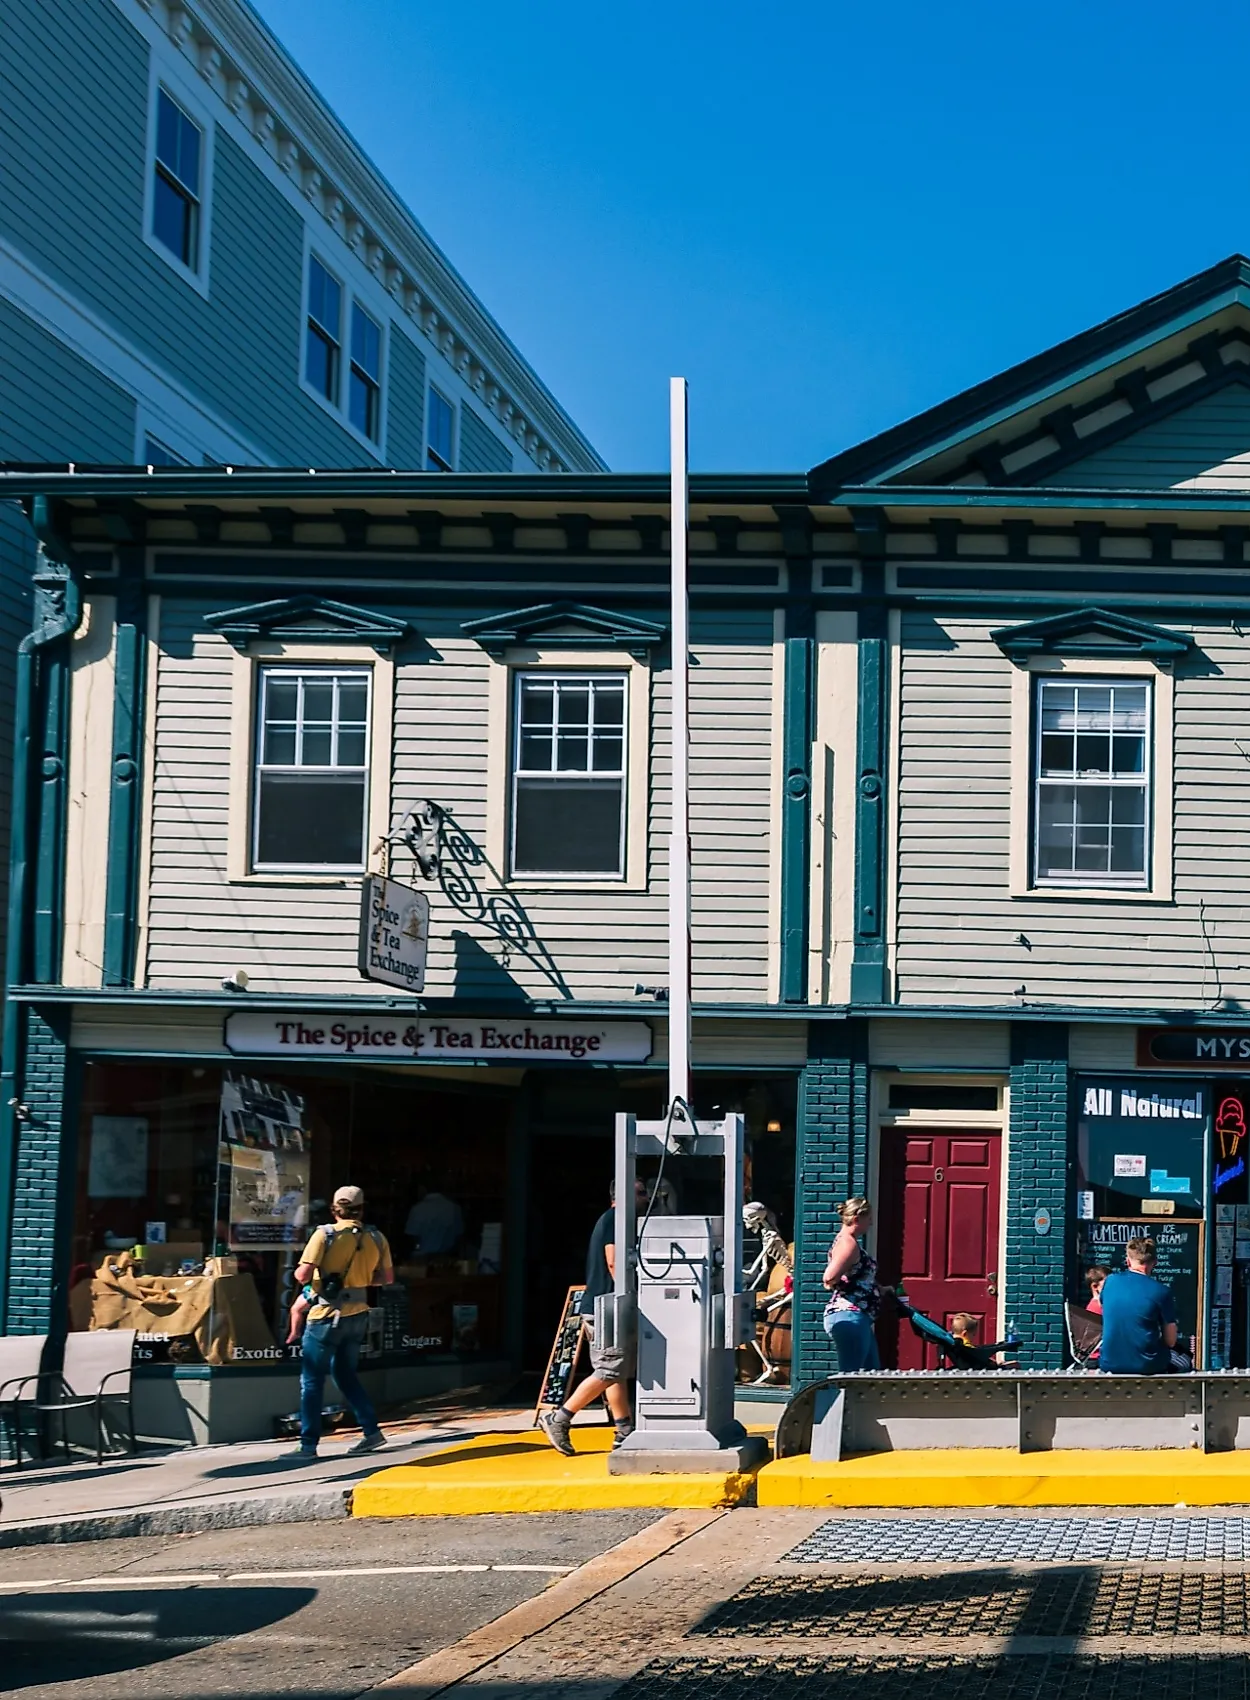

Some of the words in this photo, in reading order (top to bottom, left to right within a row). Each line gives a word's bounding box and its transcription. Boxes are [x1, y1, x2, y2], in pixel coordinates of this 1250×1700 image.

[372, 899, 400, 926] Spice
[383, 927, 401, 950] Tea
[370, 946, 419, 984] Exchange
[275, 1022, 324, 1045] The
[330, 1023, 396, 1052] Spice
[402, 1026, 424, 1048] &
[429, 1026, 474, 1049] Tea
[480, 1028, 601, 1058] Exchange
[1083, 1087, 1113, 1116] All
[1120, 1089, 1203, 1119] Natural
[930, 1162, 939, 1176] 6
[1162, 1224, 1176, 1234] ICE
[232, 1345, 283, 1360] Exotic
[401, 1334, 442, 1349] Sugars
